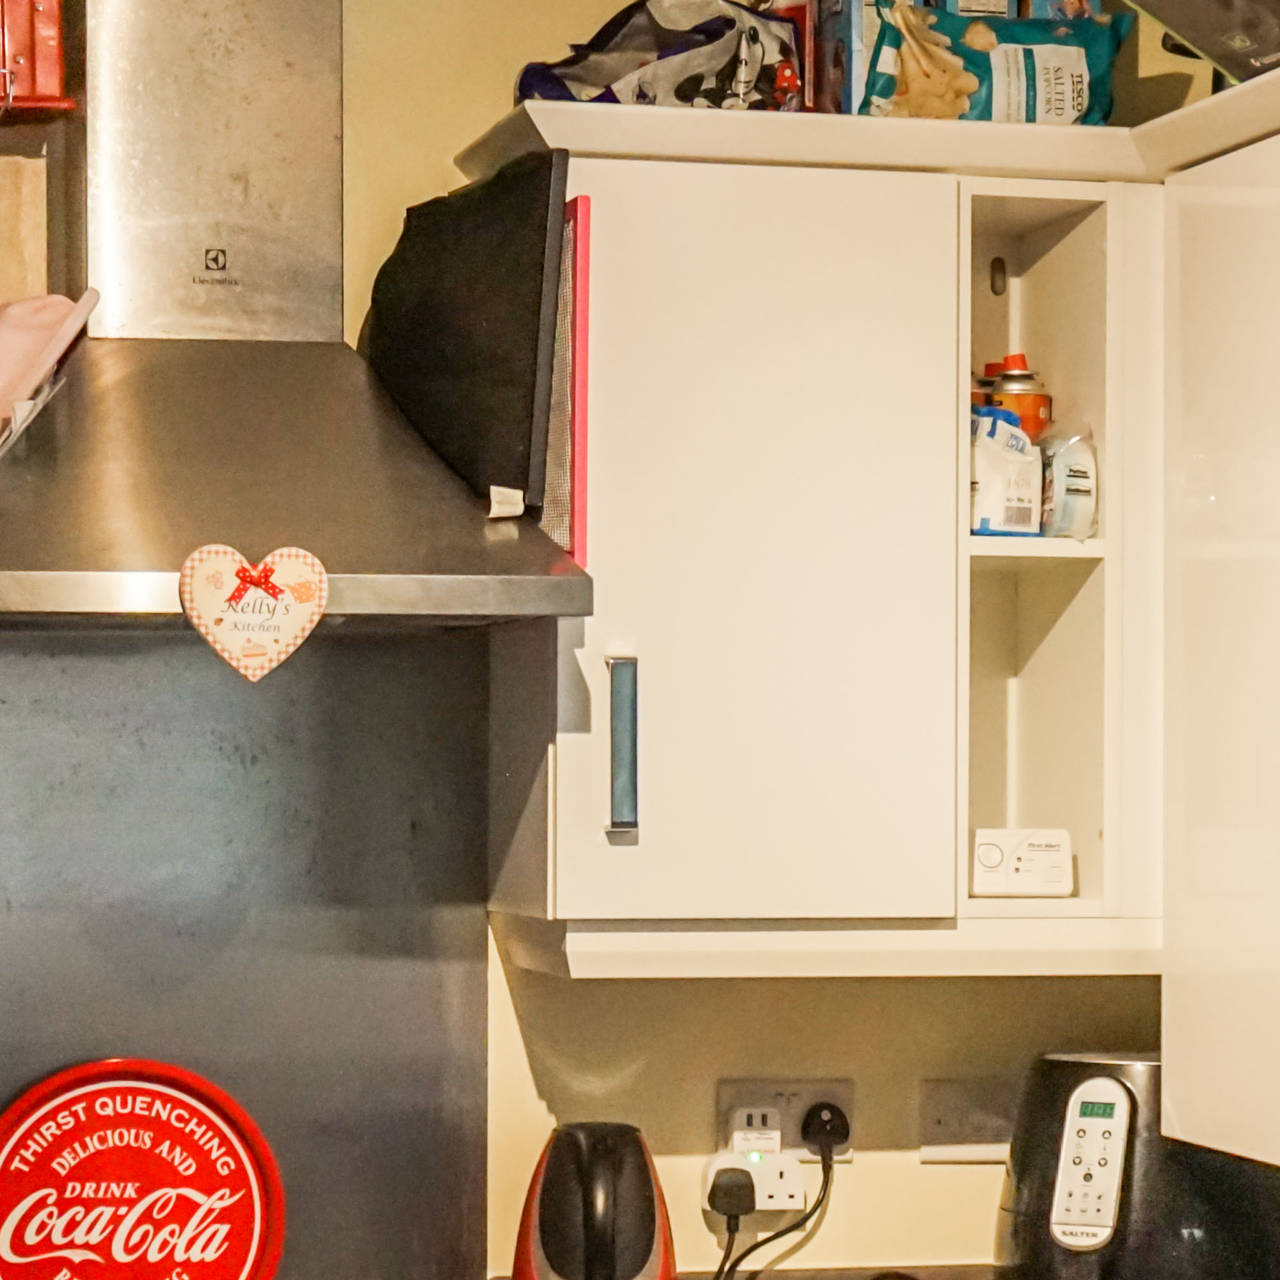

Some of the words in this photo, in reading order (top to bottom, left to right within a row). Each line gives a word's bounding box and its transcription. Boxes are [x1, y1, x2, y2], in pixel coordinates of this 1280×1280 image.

[1053, 66, 1065, 117] SALTED
[1075, 73, 1085, 113] TESCO
[220, 597, 291, 621] Kelly's
[230, 619, 281, 634] Kitchen
[9, 1102, 88, 1175] THIRST
[94, 1095, 236, 1177] QUENCHING
[51, 1128, 154, 1177] DELICIOUS
[154, 1139, 197, 1177] AND
[64, 1182, 141, 1199] DRINK
[1061, 1230, 1099, 1239] SALTER
